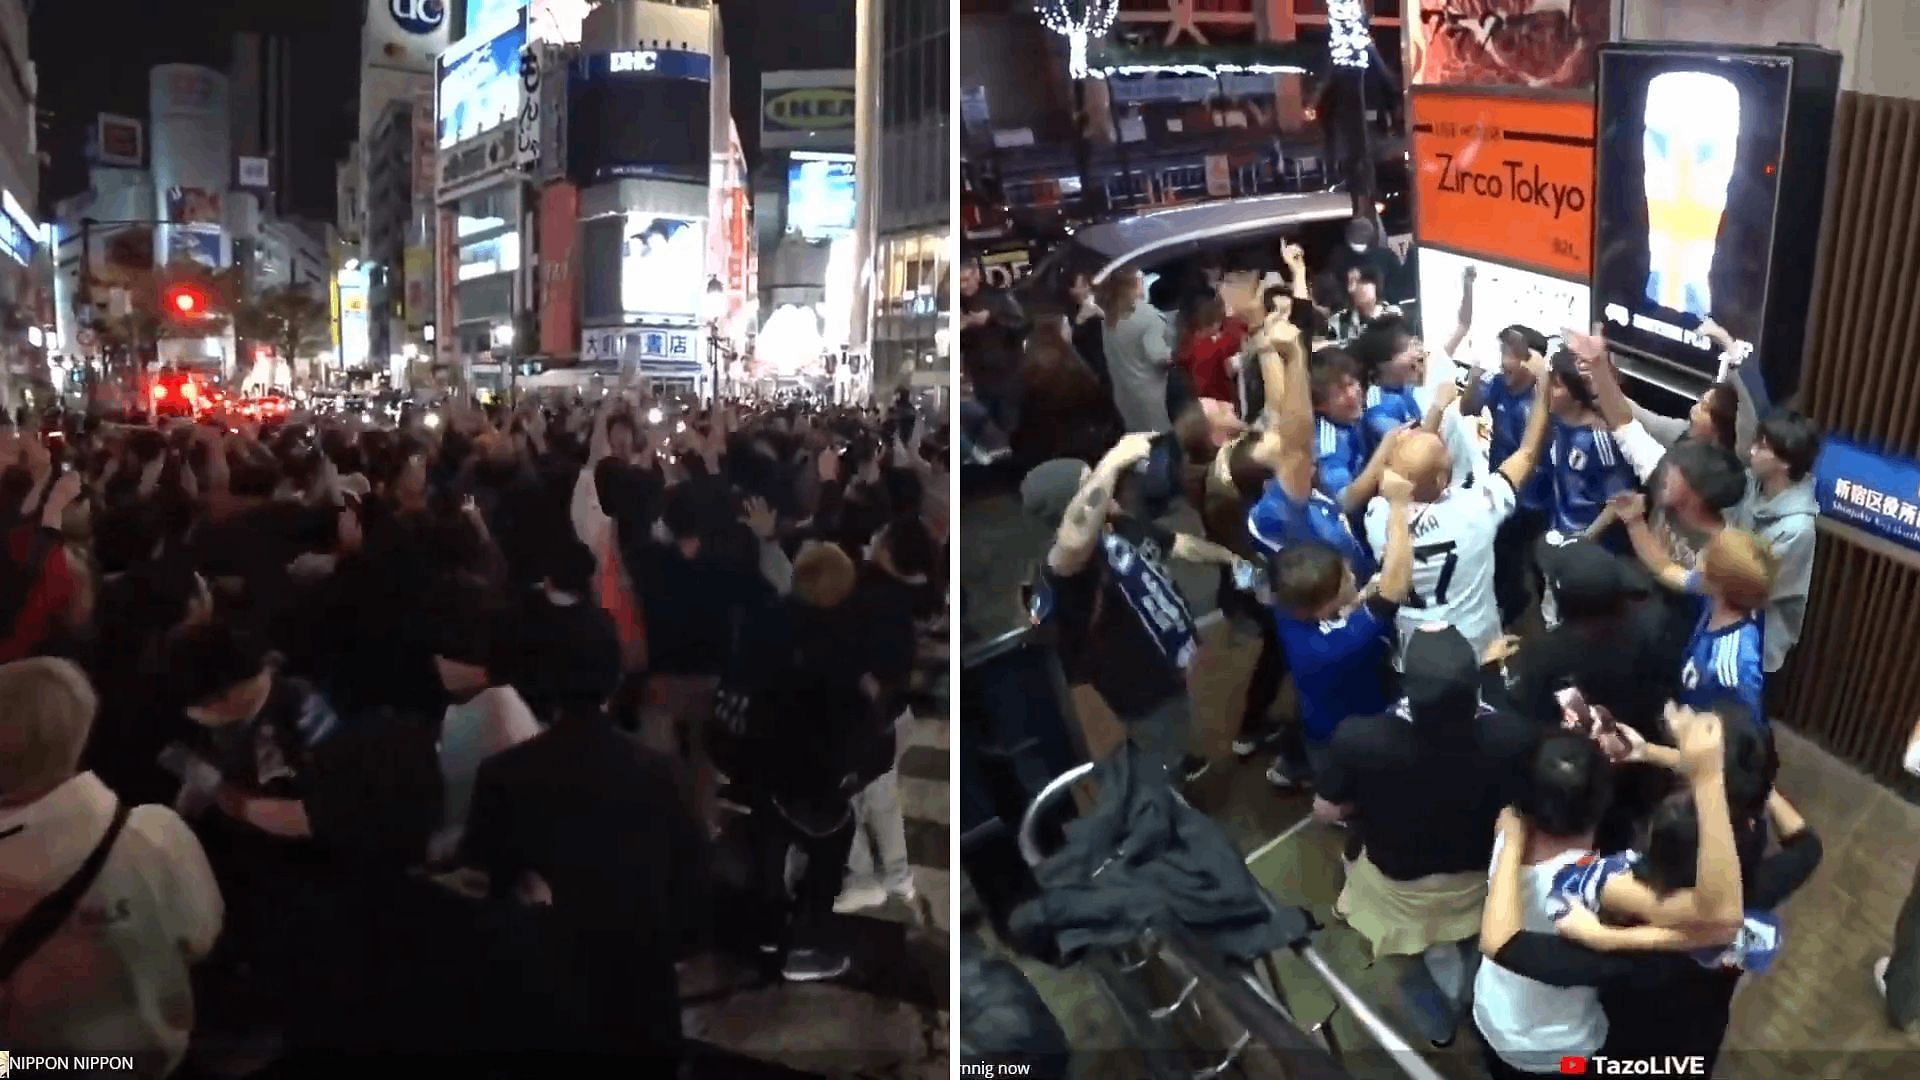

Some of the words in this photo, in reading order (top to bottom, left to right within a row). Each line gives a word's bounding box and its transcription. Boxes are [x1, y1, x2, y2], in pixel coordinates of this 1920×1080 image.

[610, 50, 657, 72] DHC
[1502, 160, 1586, 220] Tokyo
[1834, 478, 1920, 528] 新宿区役所
